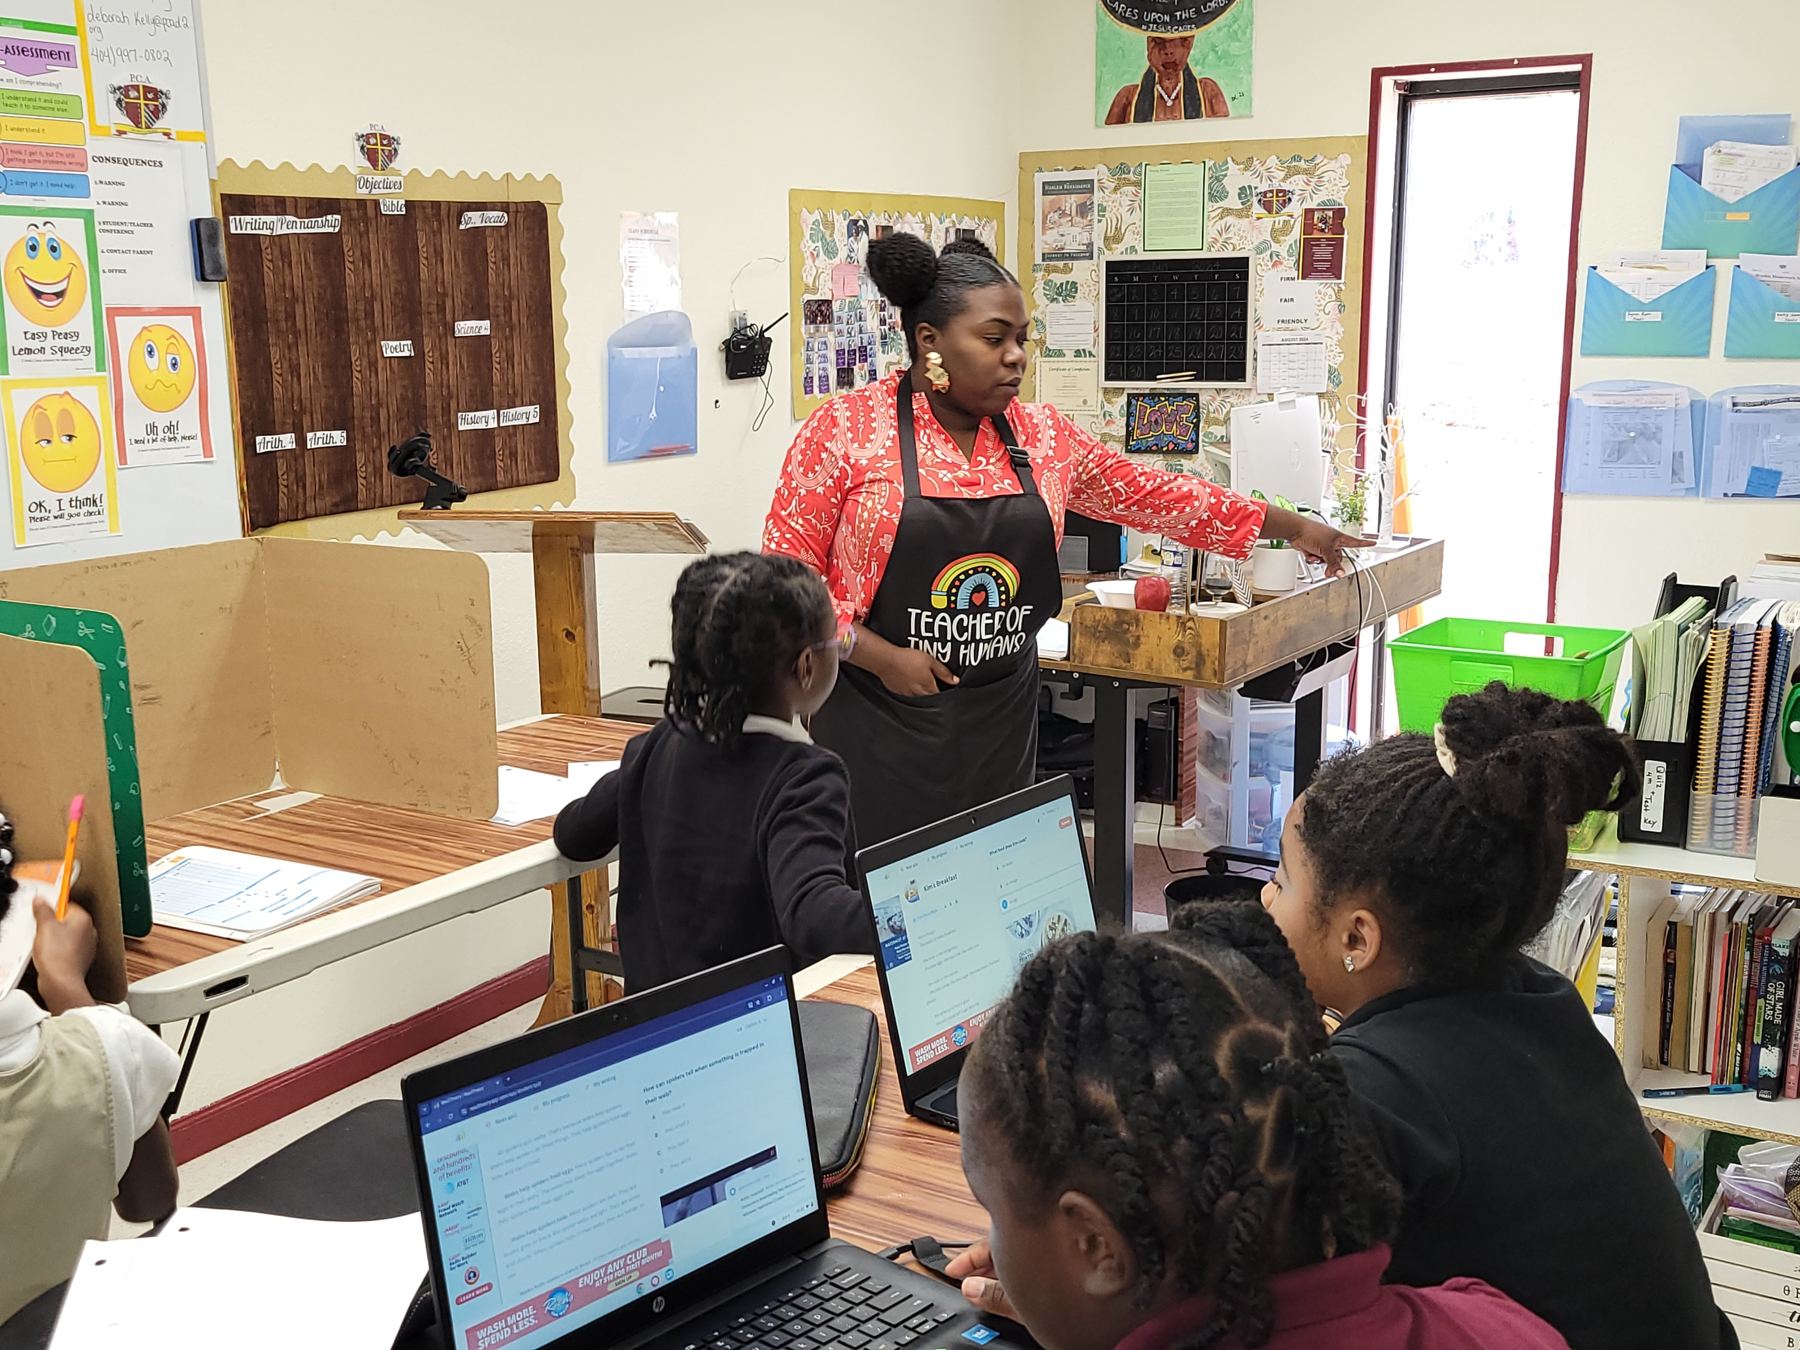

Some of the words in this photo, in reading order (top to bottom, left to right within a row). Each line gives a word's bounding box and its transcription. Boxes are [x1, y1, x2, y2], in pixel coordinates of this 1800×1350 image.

[1144, 11, 1170, 22] UPON
[1175, 8, 1197, 21] THE
[92, 155, 163, 168] CONSEQUENCES
[357, 176, 402, 193] Objectives
[382, 200, 405, 213] Bible
[24, 331, 48, 342] Easy
[51, 330, 80, 342] Peasy
[456, 323, 482, 335] Science
[12, 346, 46, 356] Lemon
[50, 345, 91, 356] Squeezy
[384, 341, 412, 356] Poetry
[459, 413, 489, 427] History
[501, 410, 530, 423] History
[532, 407, 538, 419] 5
[1135, 400, 1195, 440] LOVE
[146, 421, 158, 436] Uh
[162, 420, 180, 434] oh!
[308, 433, 337, 447] Arith.
[340, 432, 346, 444] 5
[28, 500, 51, 514] OK,
[56, 498, 65, 512] I
[69, 494, 104, 510] think!
[66, 512, 80, 520] you
[84, 508, 104, 517] check!
[907, 608, 1006, 642] TEACHER
[1006, 606, 1034, 632] OF
[908, 636, 952, 664] TINY
[1656, 766, 1666, 788] Quiz
[1644, 795, 1652, 812] Test
[1644, 817, 1658, 828] Key
[1768, 982, 1776, 993] OF
[1776, 981, 1785, 999] GIRL
[1765, 994, 1775, 1020] STARS
[1774, 1002, 1783, 1025] MADE
[914, 1045, 931, 1058] WASH
[916, 1050, 934, 1065] SPEND
[936, 1044, 950, 1056] LESS.
[456, 1178, 470, 1188] AT&T
[578, 1267, 606, 1288] ENJOY
[607, 1258, 625, 1274] ANY
[627, 1248, 648, 1264] CLUB
[614, 1269, 626, 1280] FOR
[626, 1260, 640, 1274] FIRST
[476, 1319, 506, 1340] WASH
[507, 1305, 536, 1326] MORE.
[478, 1328, 511, 1350] SPEND
[513, 1316, 538, 1334] LESS.
